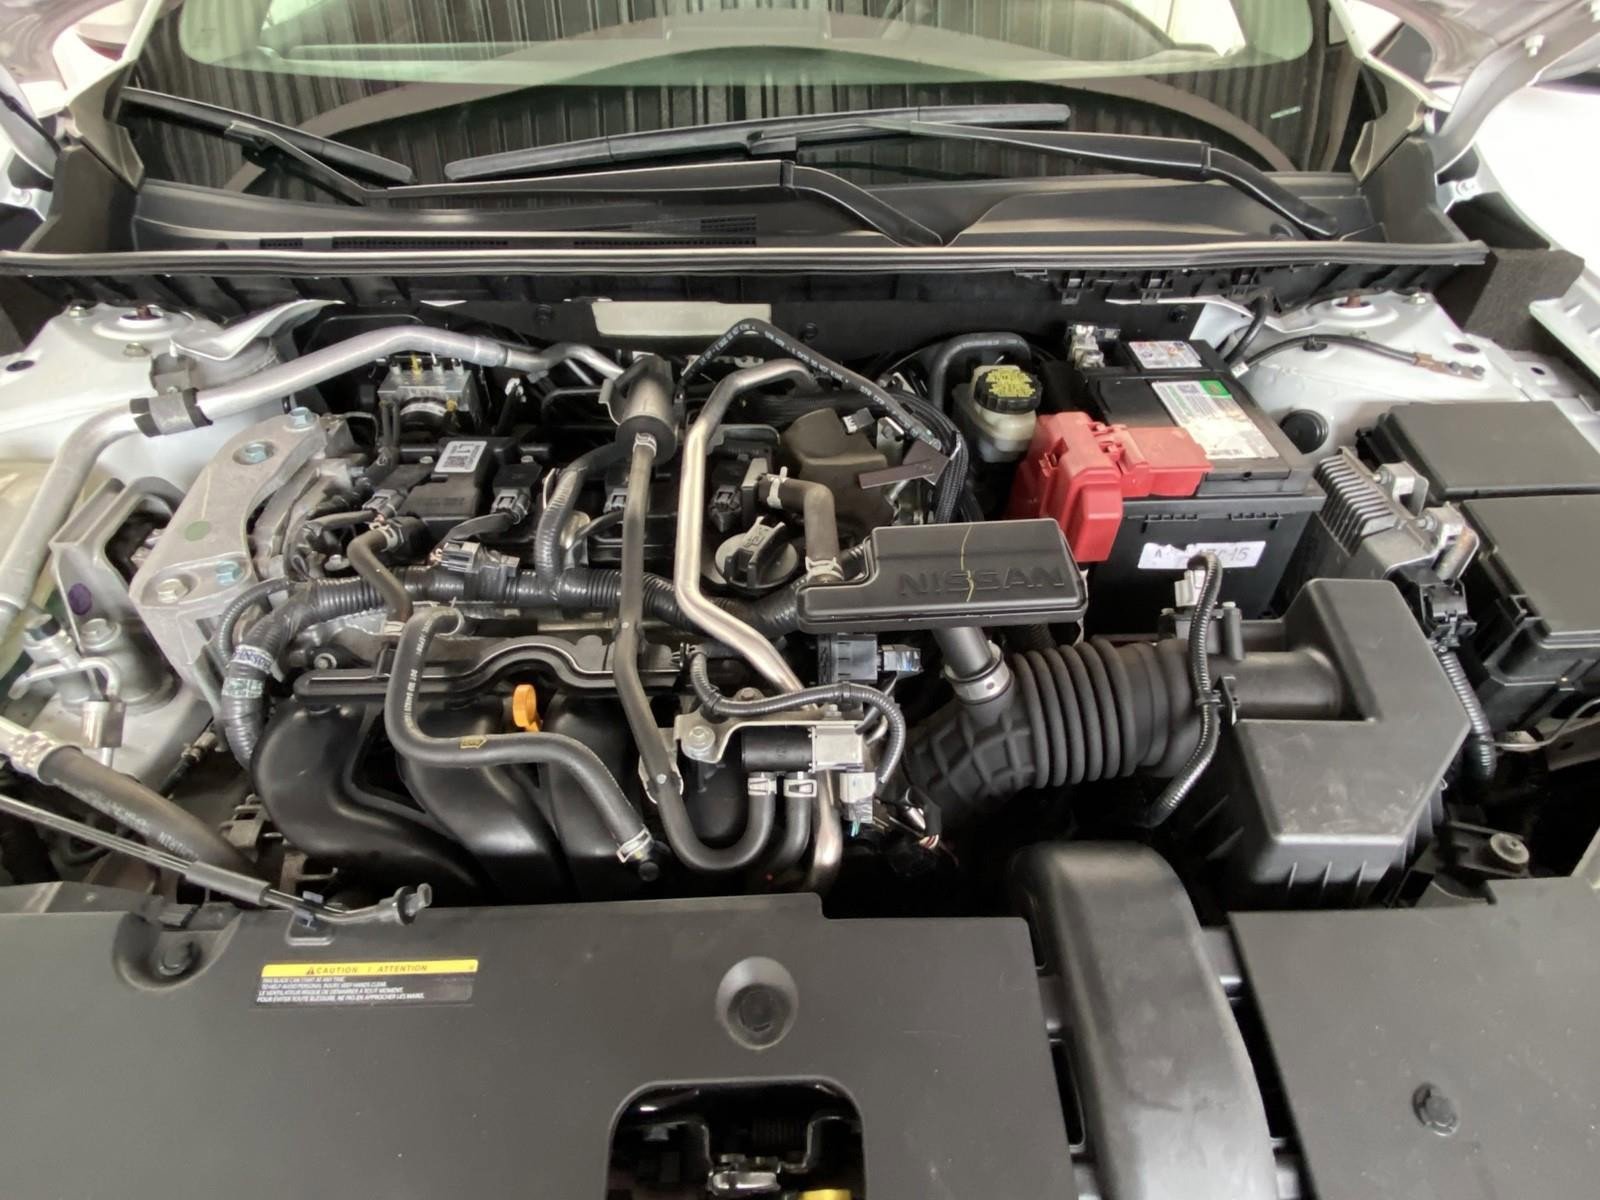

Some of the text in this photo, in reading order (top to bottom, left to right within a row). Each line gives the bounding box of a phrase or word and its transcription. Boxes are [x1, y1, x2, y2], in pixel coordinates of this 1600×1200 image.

[899, 567, 1065, 595] NISSAN
[316, 966, 358, 975] CAUTION
[377, 965, 427, 973] ATTENTION
